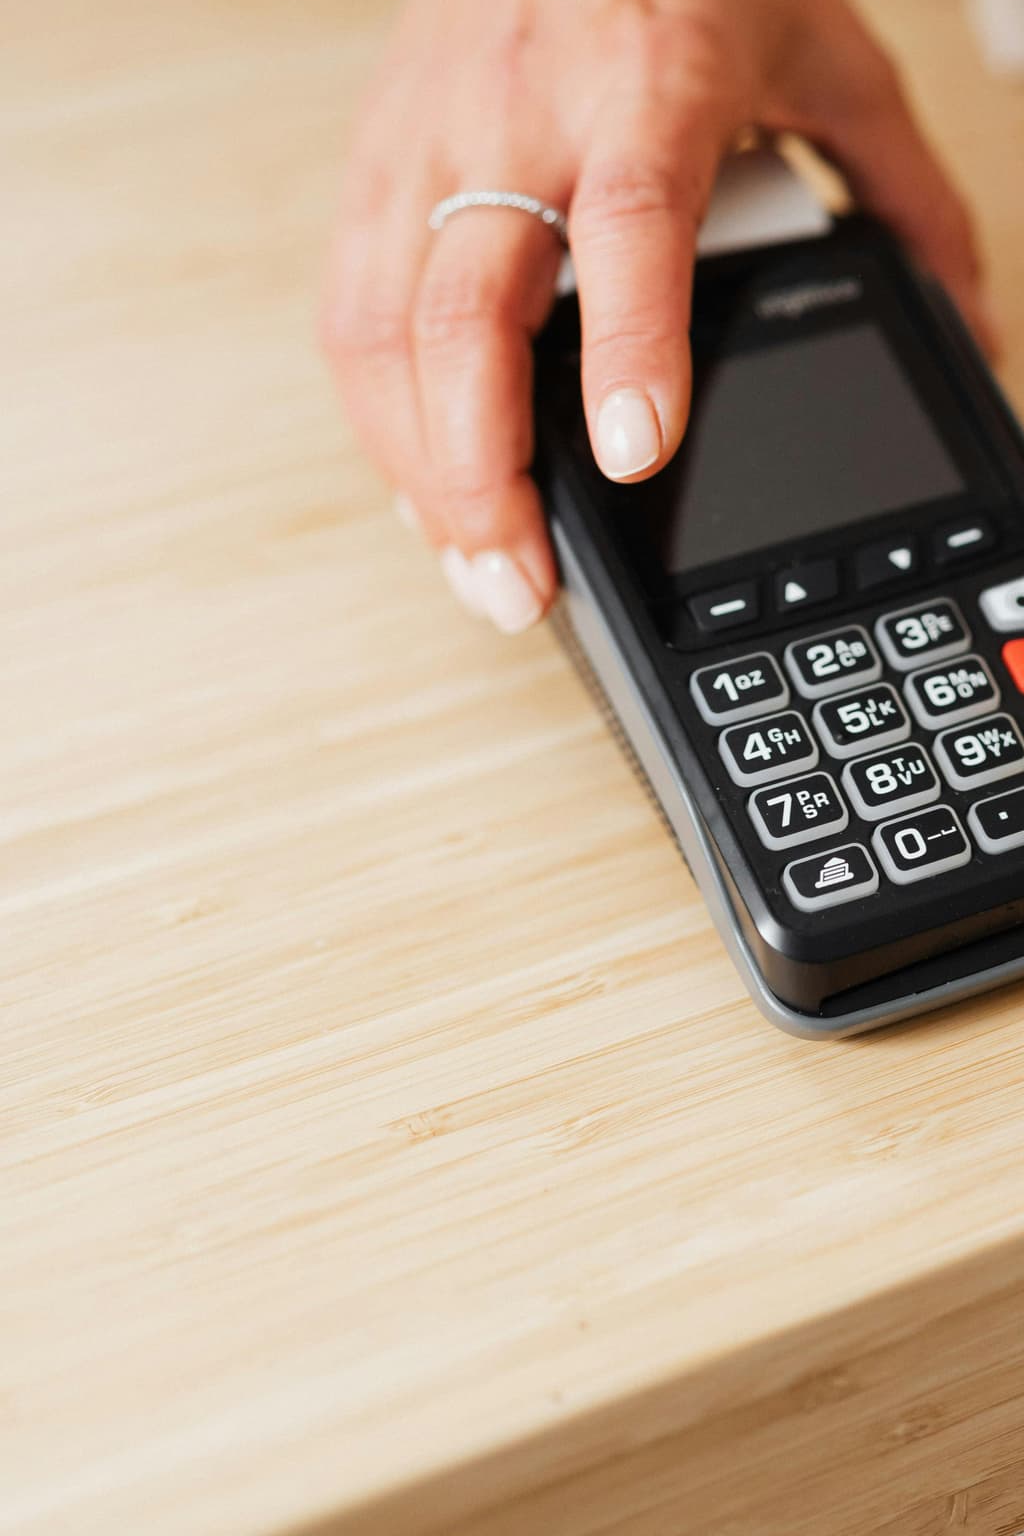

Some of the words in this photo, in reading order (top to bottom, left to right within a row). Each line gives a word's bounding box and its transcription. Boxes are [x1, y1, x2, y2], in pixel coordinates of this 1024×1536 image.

[895, 617, 929, 649] 3
[806, 644, 840, 677] 2
[713, 672, 739, 701] 1
[923, 675, 957, 707] 6
[837, 702, 870, 733] 5
[743, 732, 772, 761] 4
[953, 735, 987, 766] 9
[865, 763, 898, 795] 8
[766, 793, 793, 828] 7
[894, 827, 927, 860] 0
